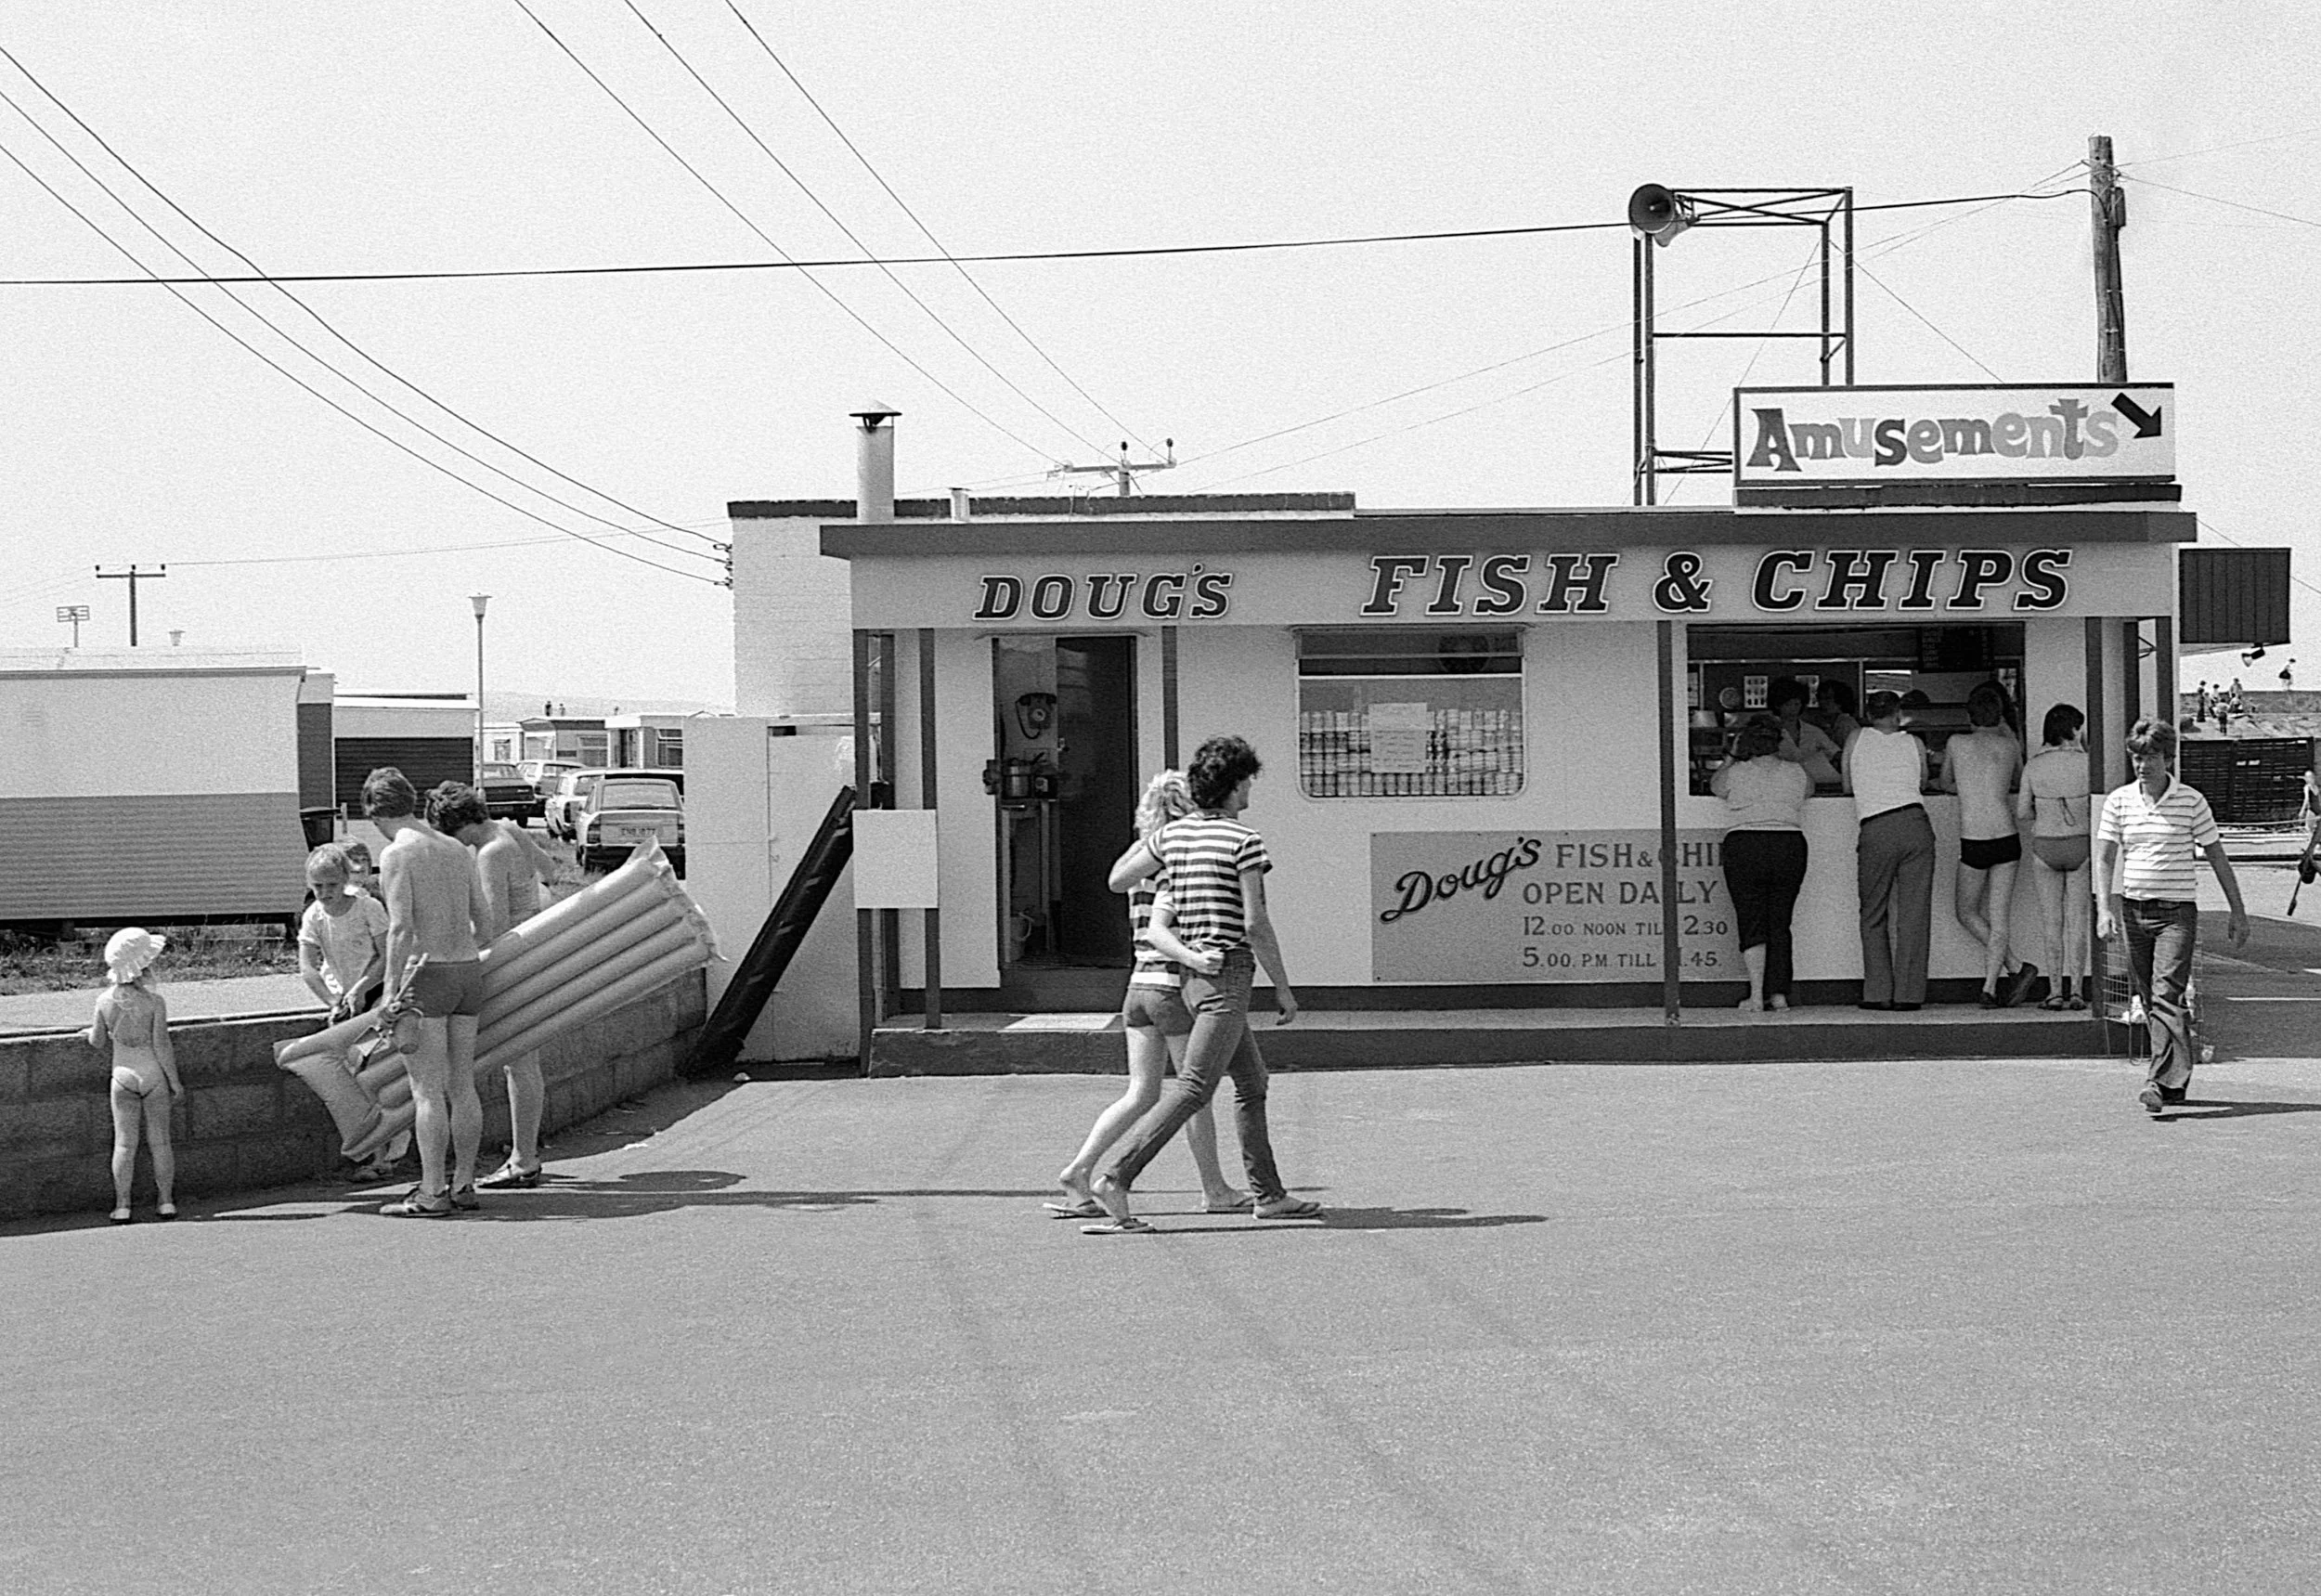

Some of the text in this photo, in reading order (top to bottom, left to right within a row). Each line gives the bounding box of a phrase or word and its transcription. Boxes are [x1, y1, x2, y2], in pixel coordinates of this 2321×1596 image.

[1746, 398, 2119, 472] Amusements
[973, 549, 2072, 620] DOUG'S FISH & CHIPS
[1381, 837, 1541, 923] Doug's
[1523, 881, 1718, 904] OPEN DALY
[1583, 923, 1626, 935] NOON
[1635, 922, 1664, 935] TIL
[1617, 953, 1656, 967] TILL
